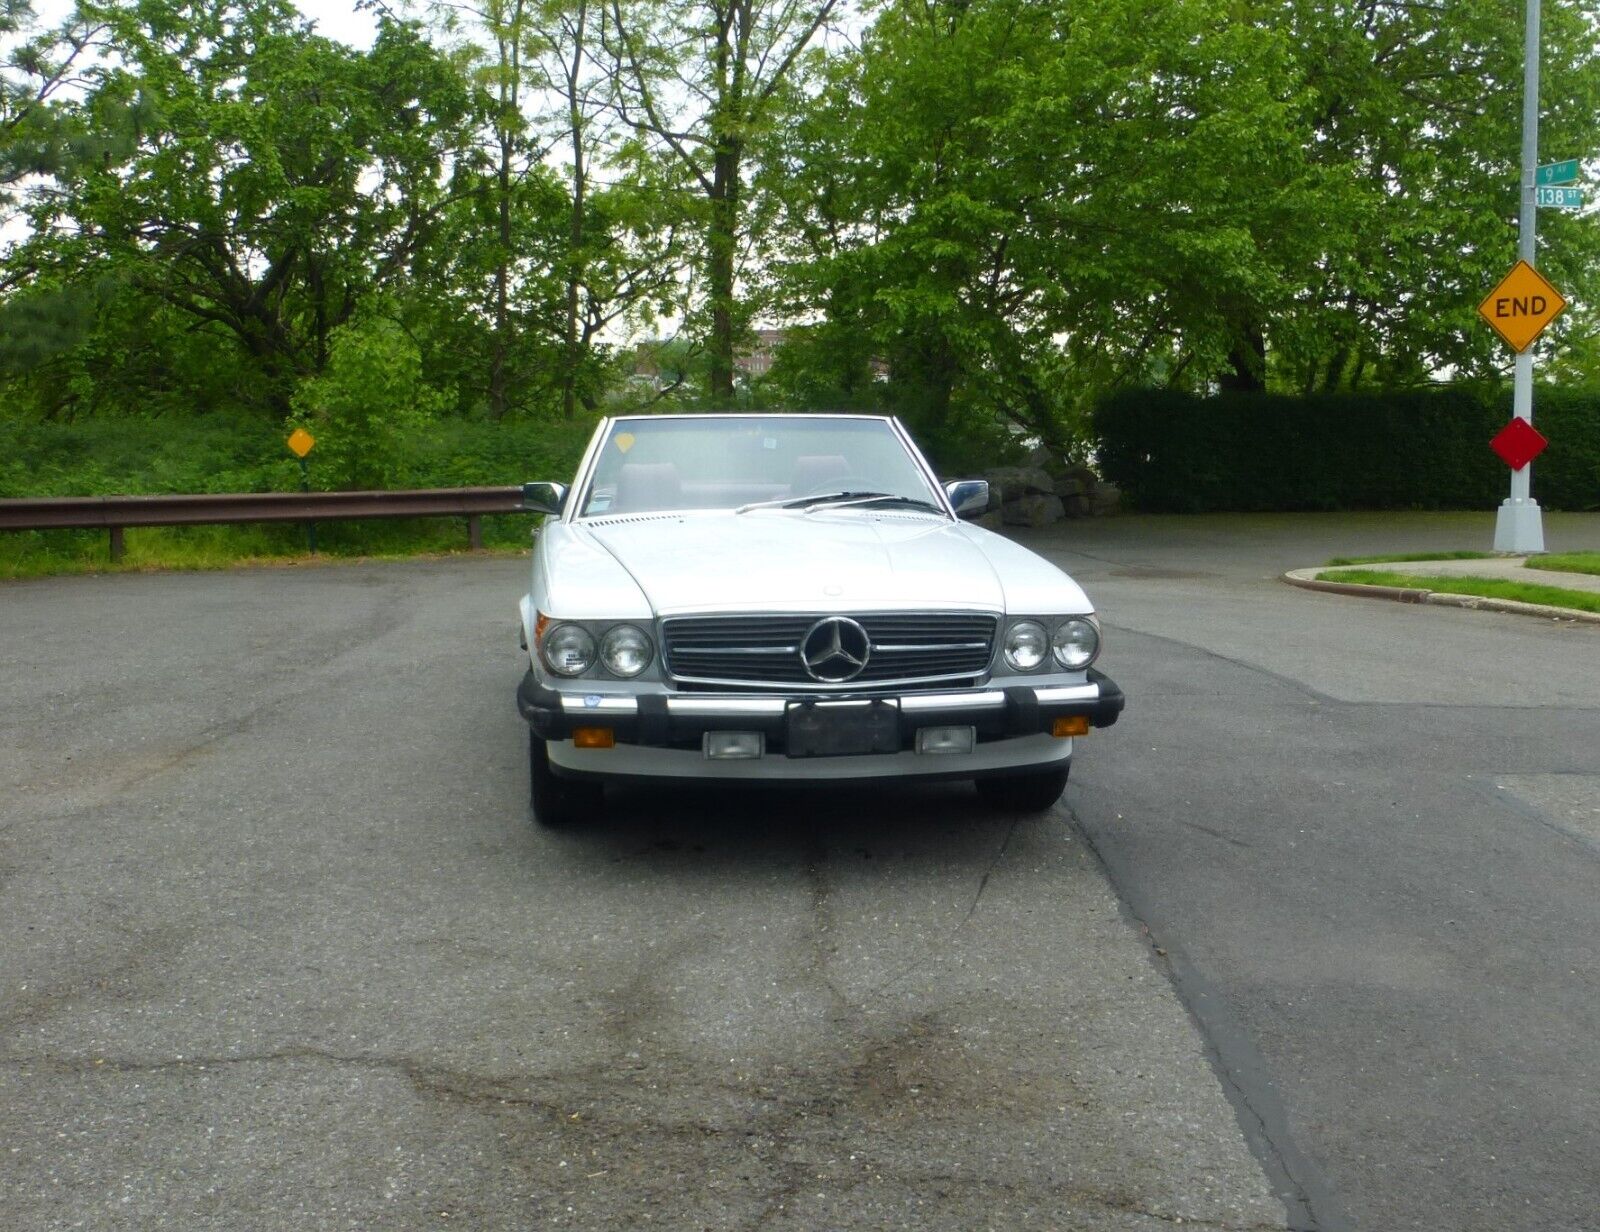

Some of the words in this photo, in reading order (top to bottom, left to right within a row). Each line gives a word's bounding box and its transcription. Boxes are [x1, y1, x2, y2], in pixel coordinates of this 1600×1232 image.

[1546, 167, 1553, 182] 9
[1540, 189, 1564, 204] 138
[1567, 190, 1577, 198] ST
[1496, 296, 1547, 318] END
